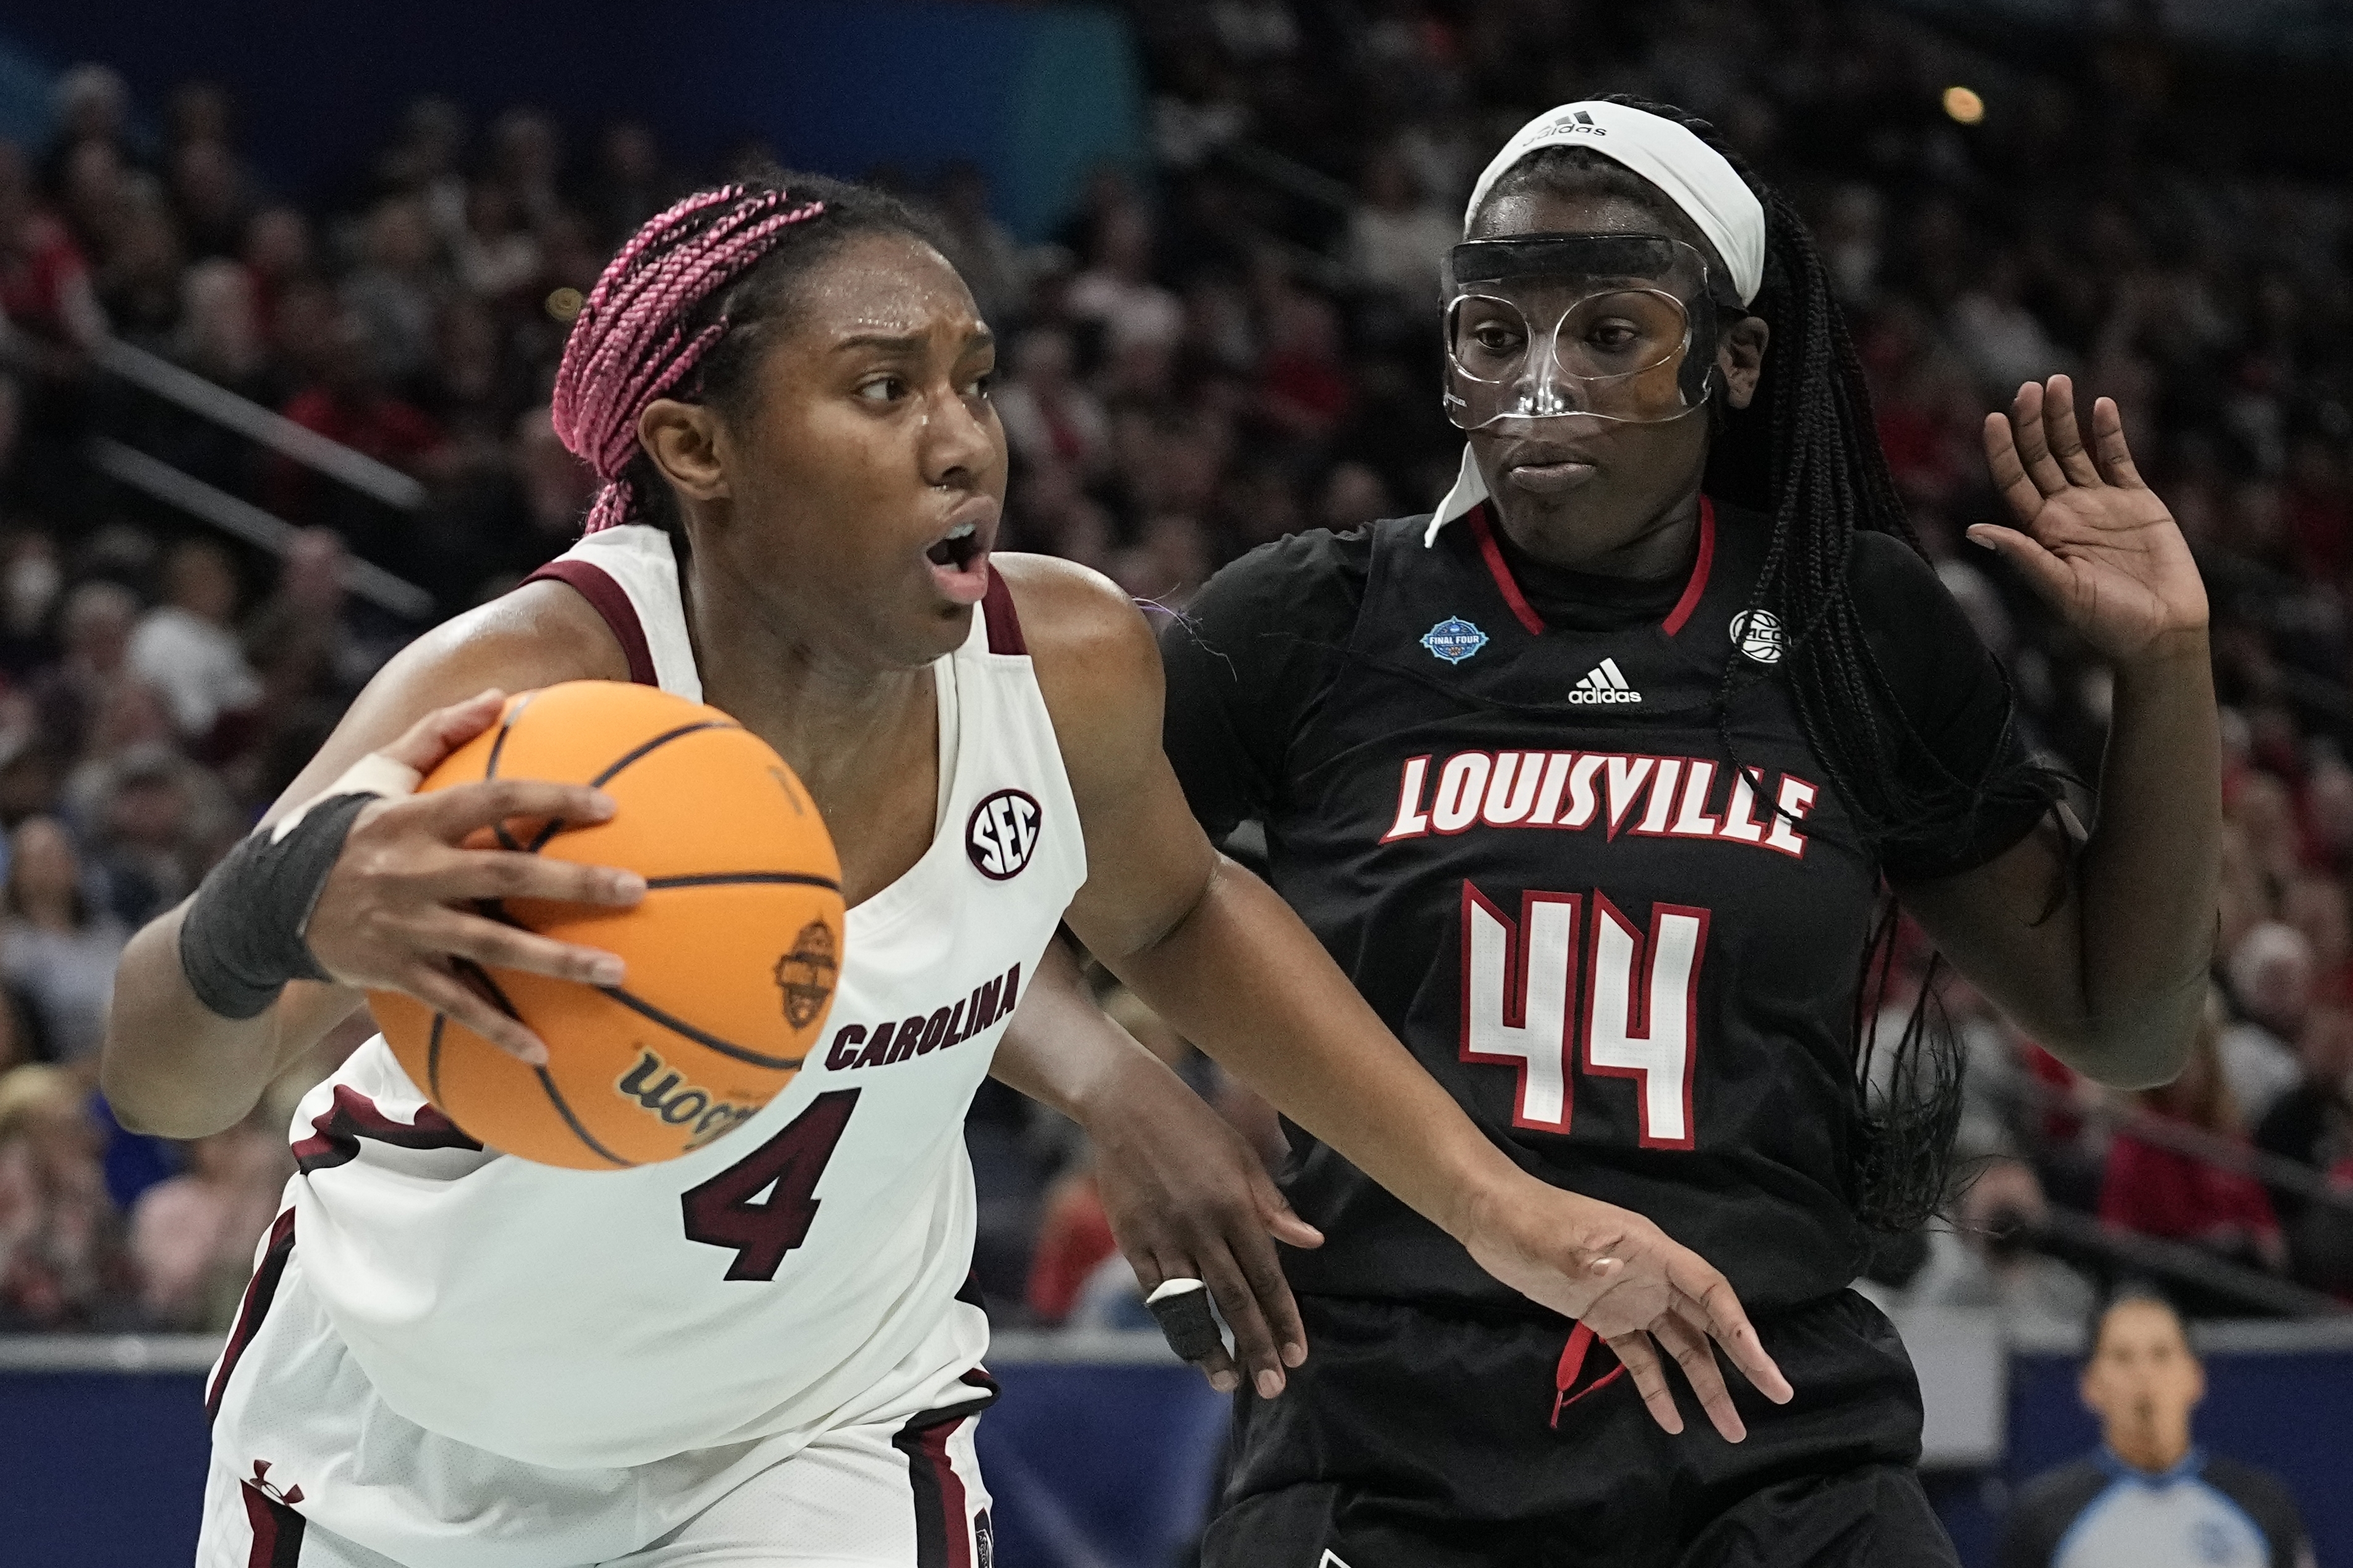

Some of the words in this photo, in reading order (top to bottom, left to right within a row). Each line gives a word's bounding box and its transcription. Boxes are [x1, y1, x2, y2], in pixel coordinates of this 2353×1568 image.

[1429, 636, 1454, 645] FINAL
[1455, 635, 1480, 644] FOUR
[1568, 687, 1642, 704] adidas
[973, 795, 1036, 874] SEC
[1379, 748, 1819, 859] LOUISVILLE
[824, 961, 1021, 1071] CAROLINA
[1459, 878, 1711, 1150] 44
[680, 1086, 861, 1282] 4
